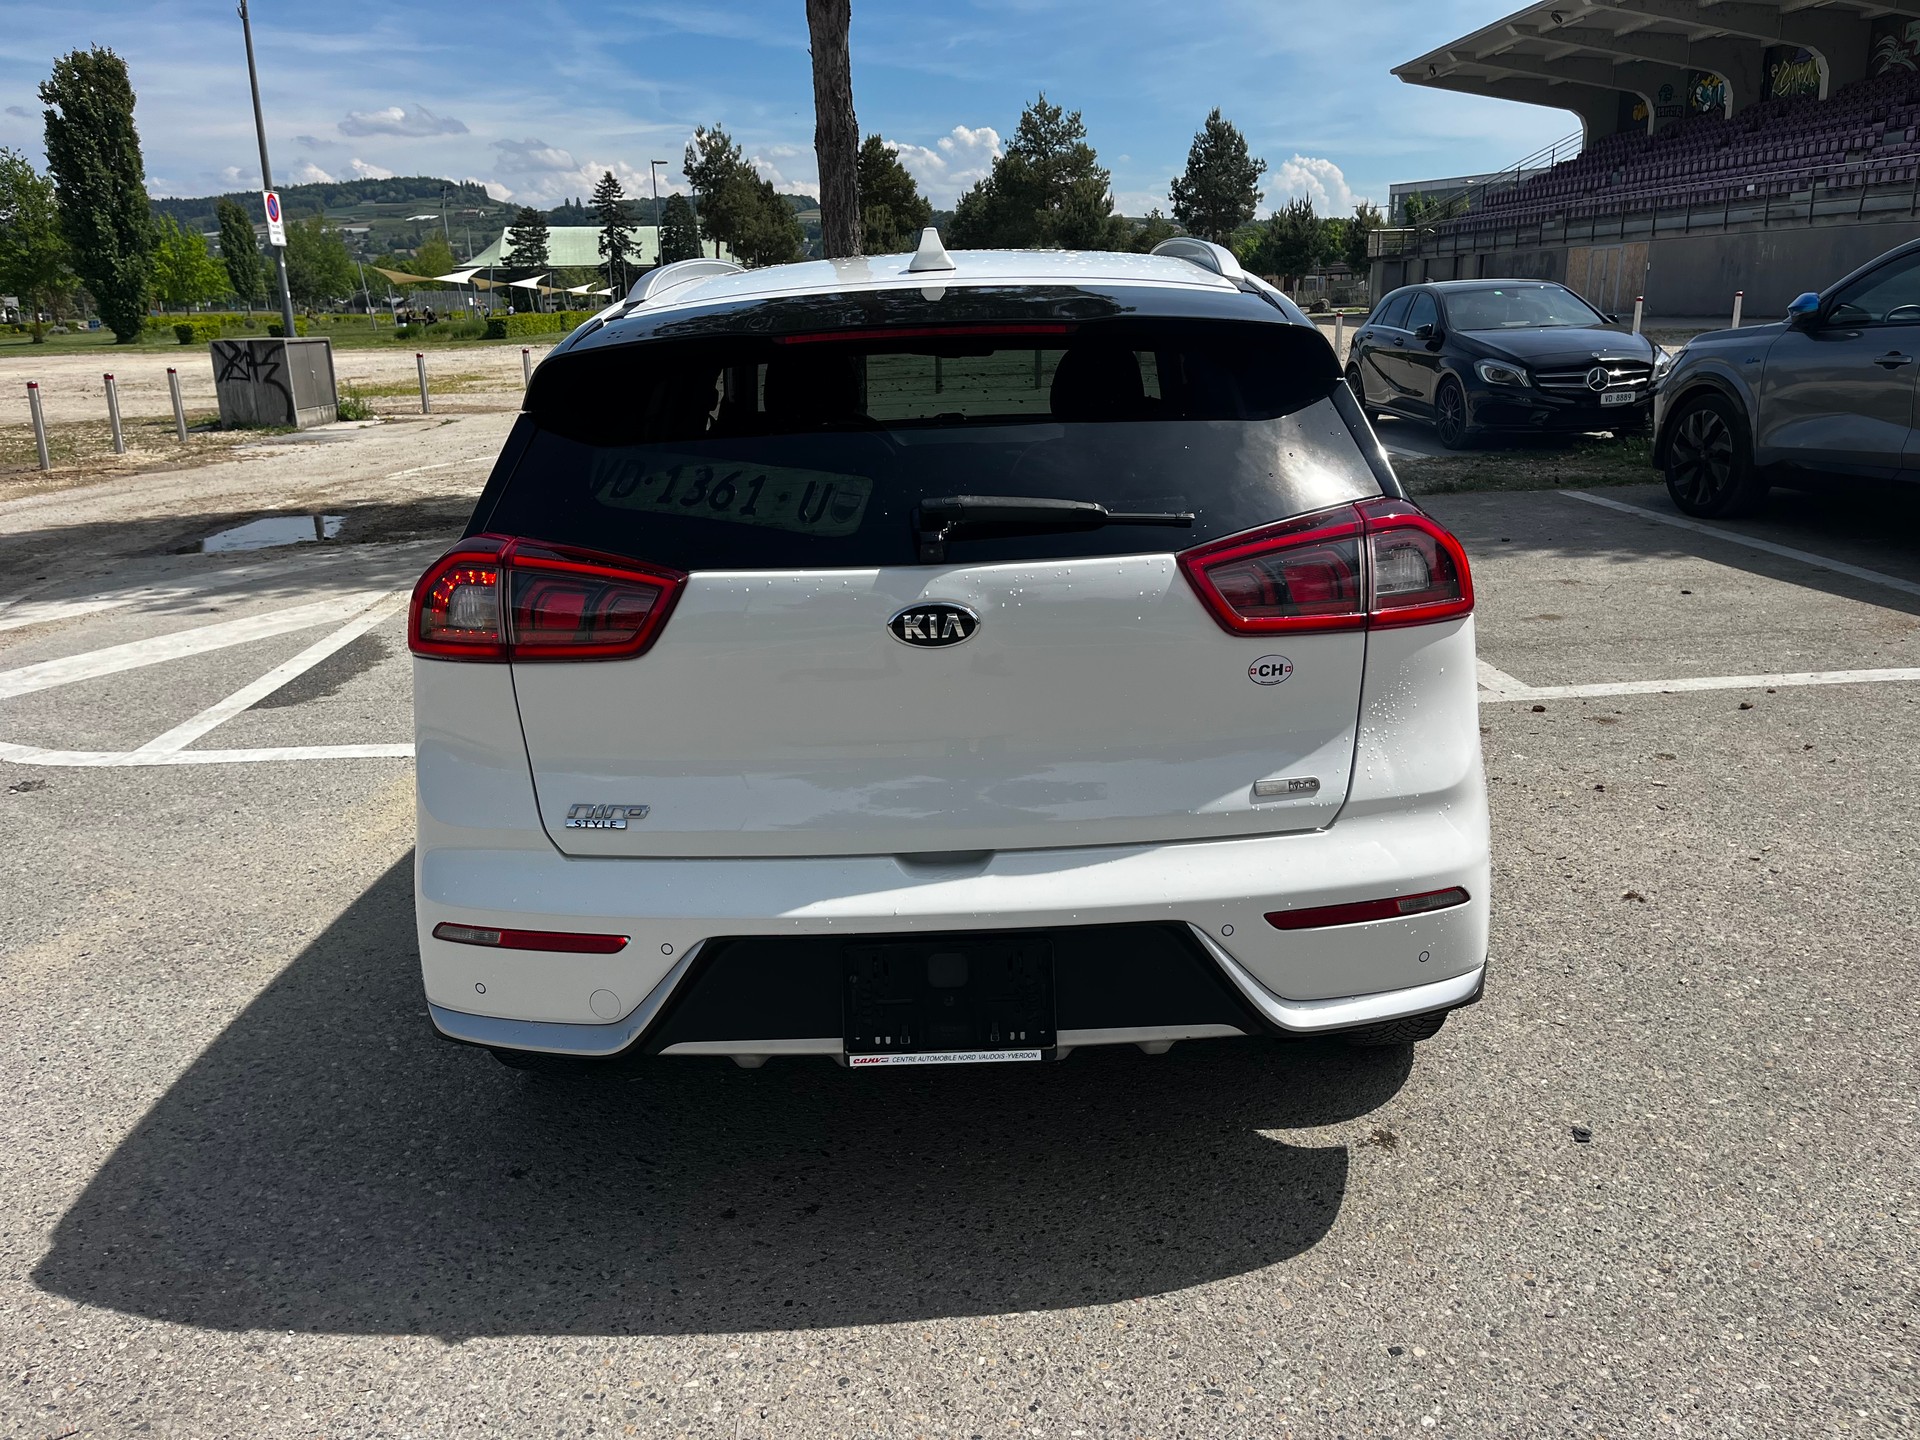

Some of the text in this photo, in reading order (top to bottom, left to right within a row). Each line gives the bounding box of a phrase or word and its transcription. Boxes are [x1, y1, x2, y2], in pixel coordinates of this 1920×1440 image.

[1605, 393, 1631, 402] VD 8889
[903, 612, 966, 640] KIA
[1258, 663, 1284, 677] CH
[574, 820, 617, 829] STYLE
[917, 1054, 957, 1063] AUTOMOBILE
[957, 1053, 976, 1061] NORD
